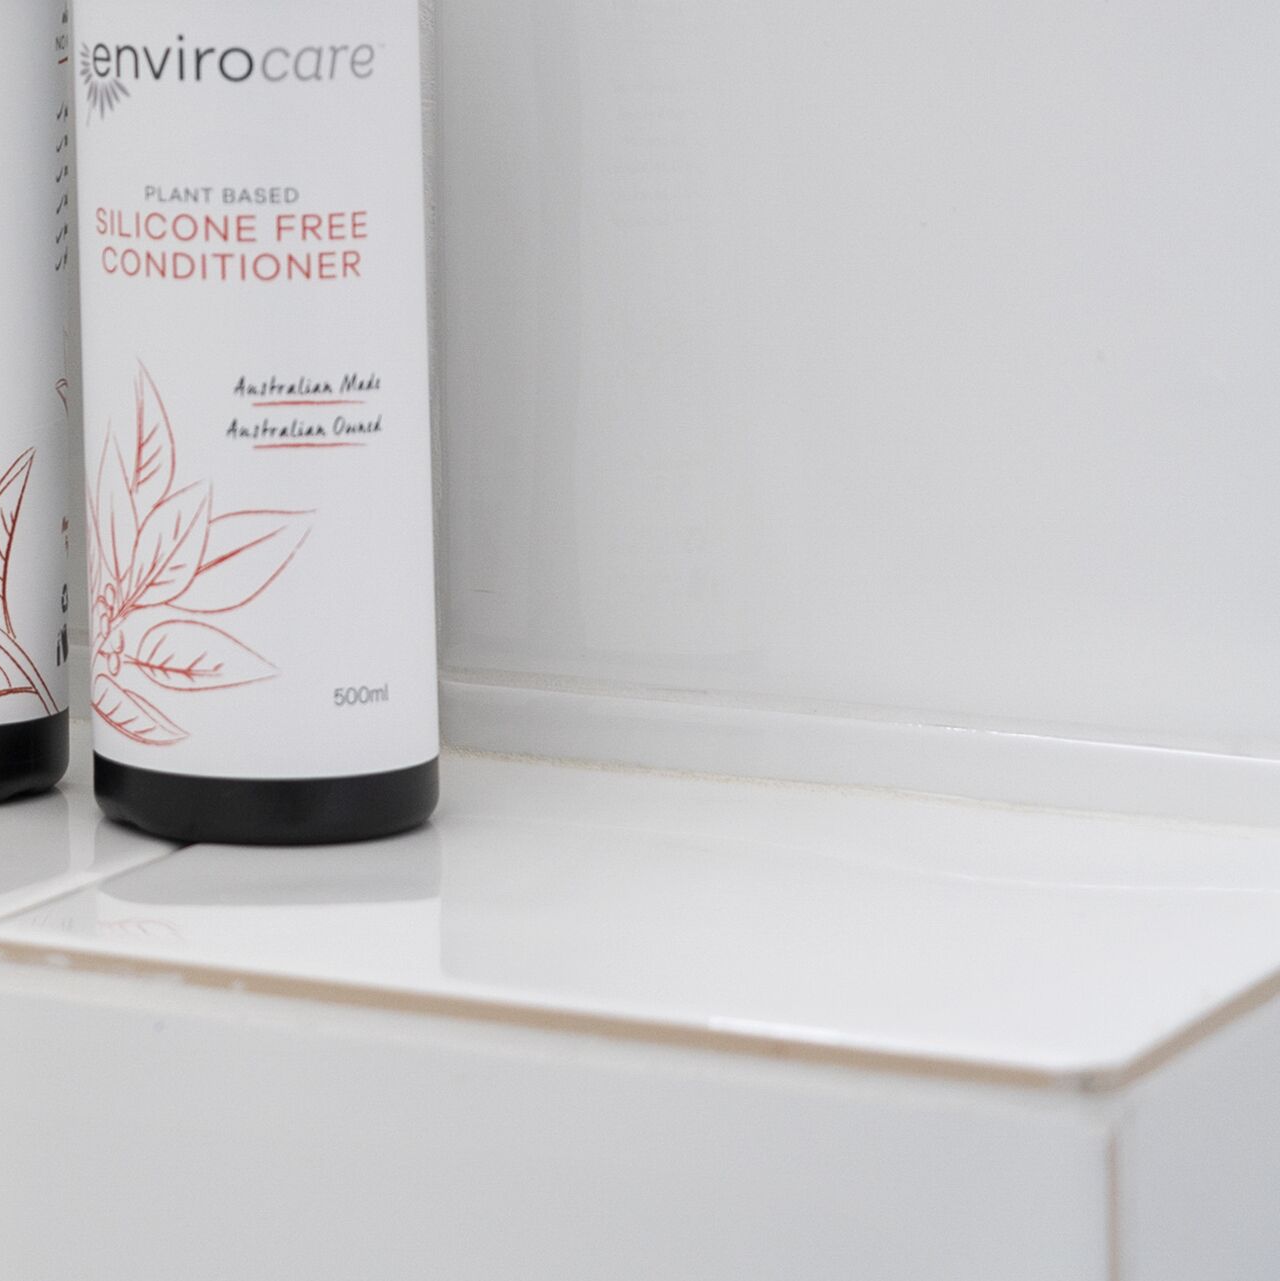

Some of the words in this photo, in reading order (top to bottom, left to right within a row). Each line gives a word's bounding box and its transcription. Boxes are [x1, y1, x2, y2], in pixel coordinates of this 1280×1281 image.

[93, 34, 376, 83] envirocare
[145, 185, 214, 204] PLANT
[222, 187, 300, 204] BASED
[96, 207, 258, 243] SILICONE
[276, 211, 369, 242] FREE
[102, 246, 362, 282] CONDITIONER
[234, 375, 333, 396] Australian
[226, 418, 326, 439] Australian
[333, 683, 390, 707] 500ml
